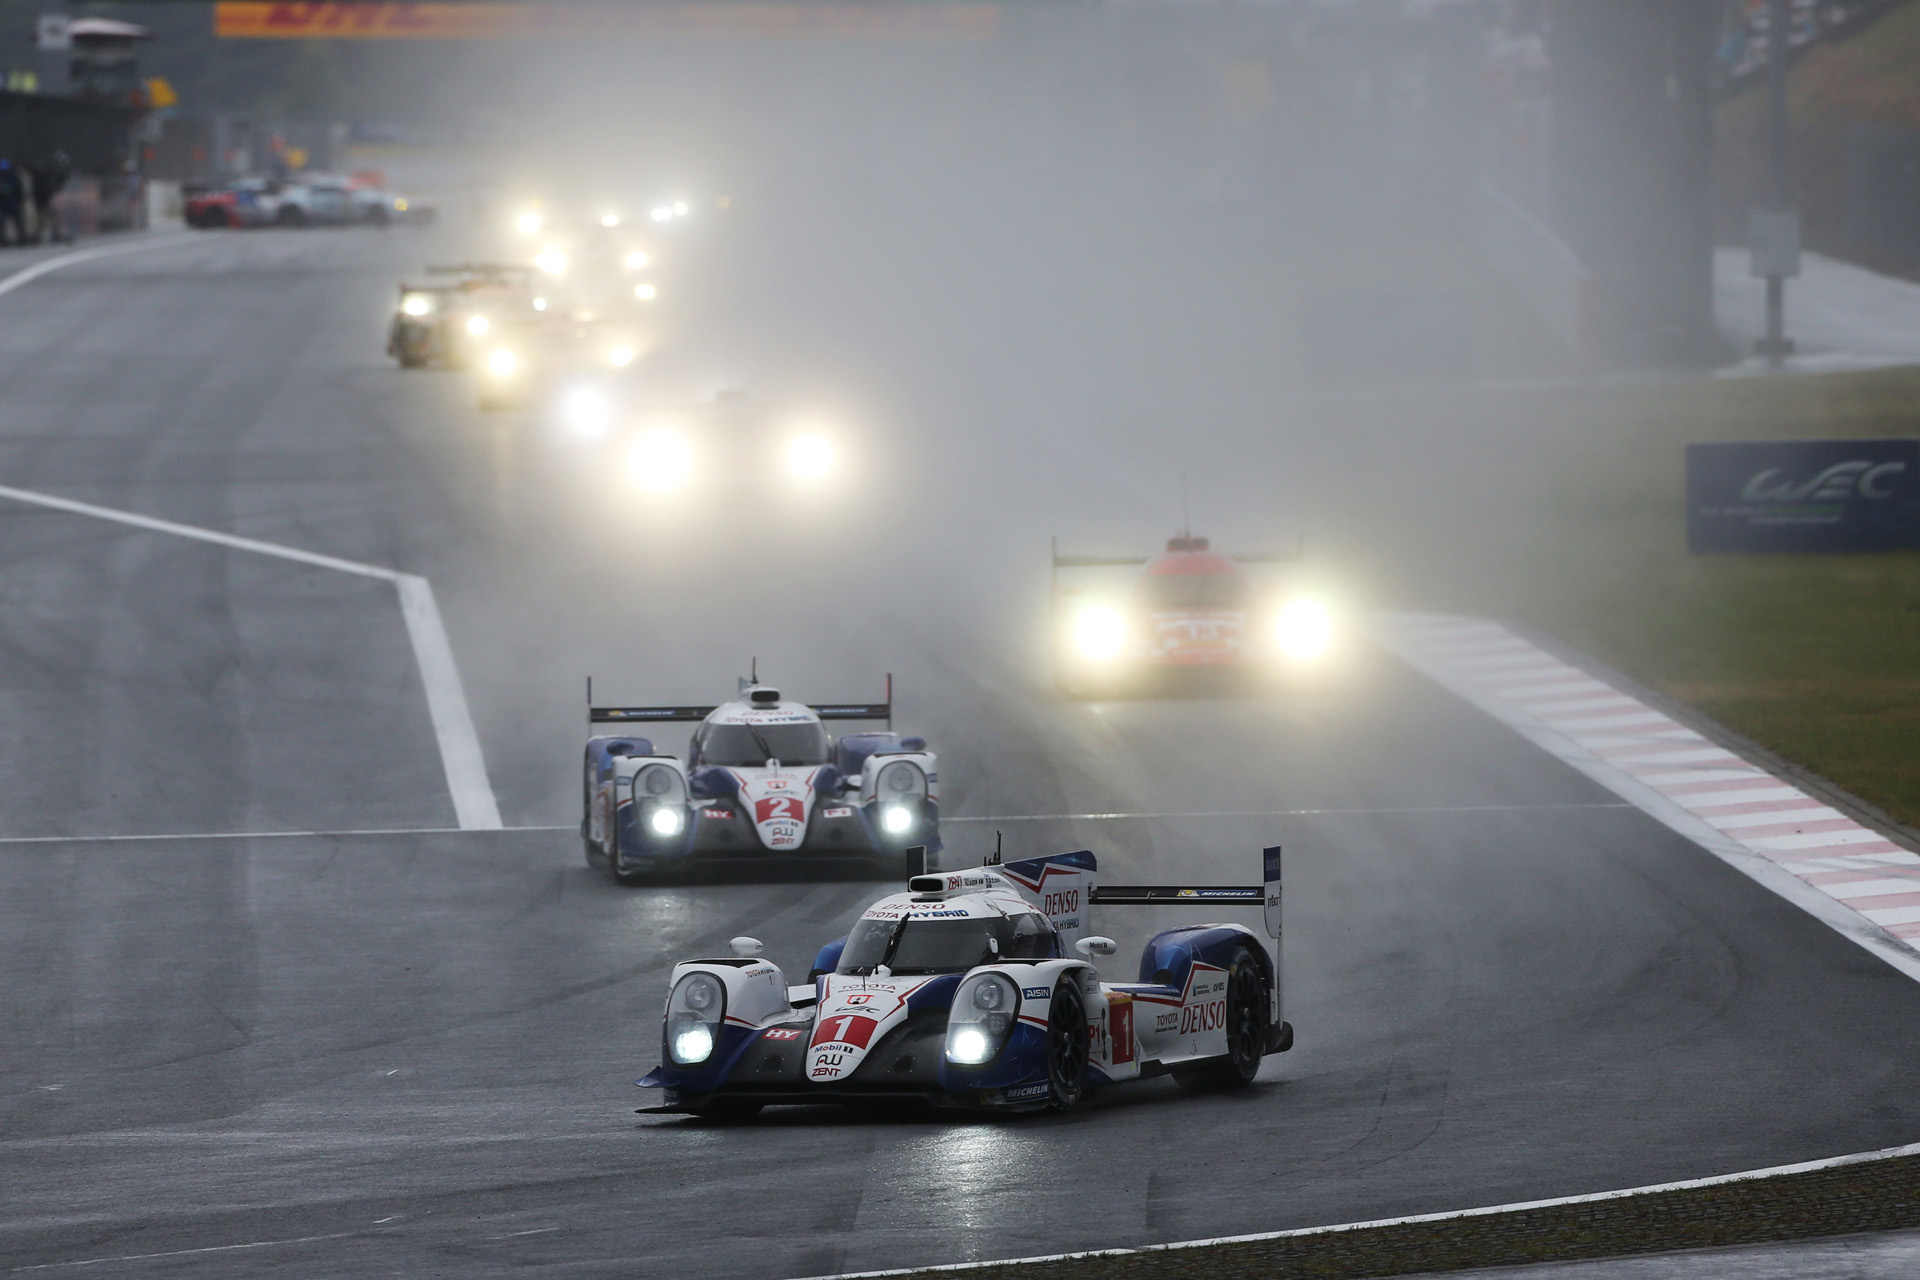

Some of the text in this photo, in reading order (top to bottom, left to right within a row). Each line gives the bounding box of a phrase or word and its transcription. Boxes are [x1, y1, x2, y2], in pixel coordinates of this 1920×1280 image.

[1740, 460, 1906, 501] WEC
[769, 798, 792, 818] 2
[1044, 889, 1079, 917] DENSO
[867, 909, 970, 919] TOYOTA HYBRID
[841, 983, 896, 991] TOYOTA
[1026, 988, 1049, 998] AISIN
[1156, 1012, 1179, 1026] TOYOTA
[1180, 1000, 1226, 1036] DENSO
[764, 1029, 800, 1039] HY
[832, 1015, 854, 1041] 1
[1122, 1010, 1130, 1056] 1
[814, 1044, 854, 1054] Mobil 1
[811, 1067, 842, 1078] ZENT
[1006, 1083, 1049, 1098] MICHELIN
